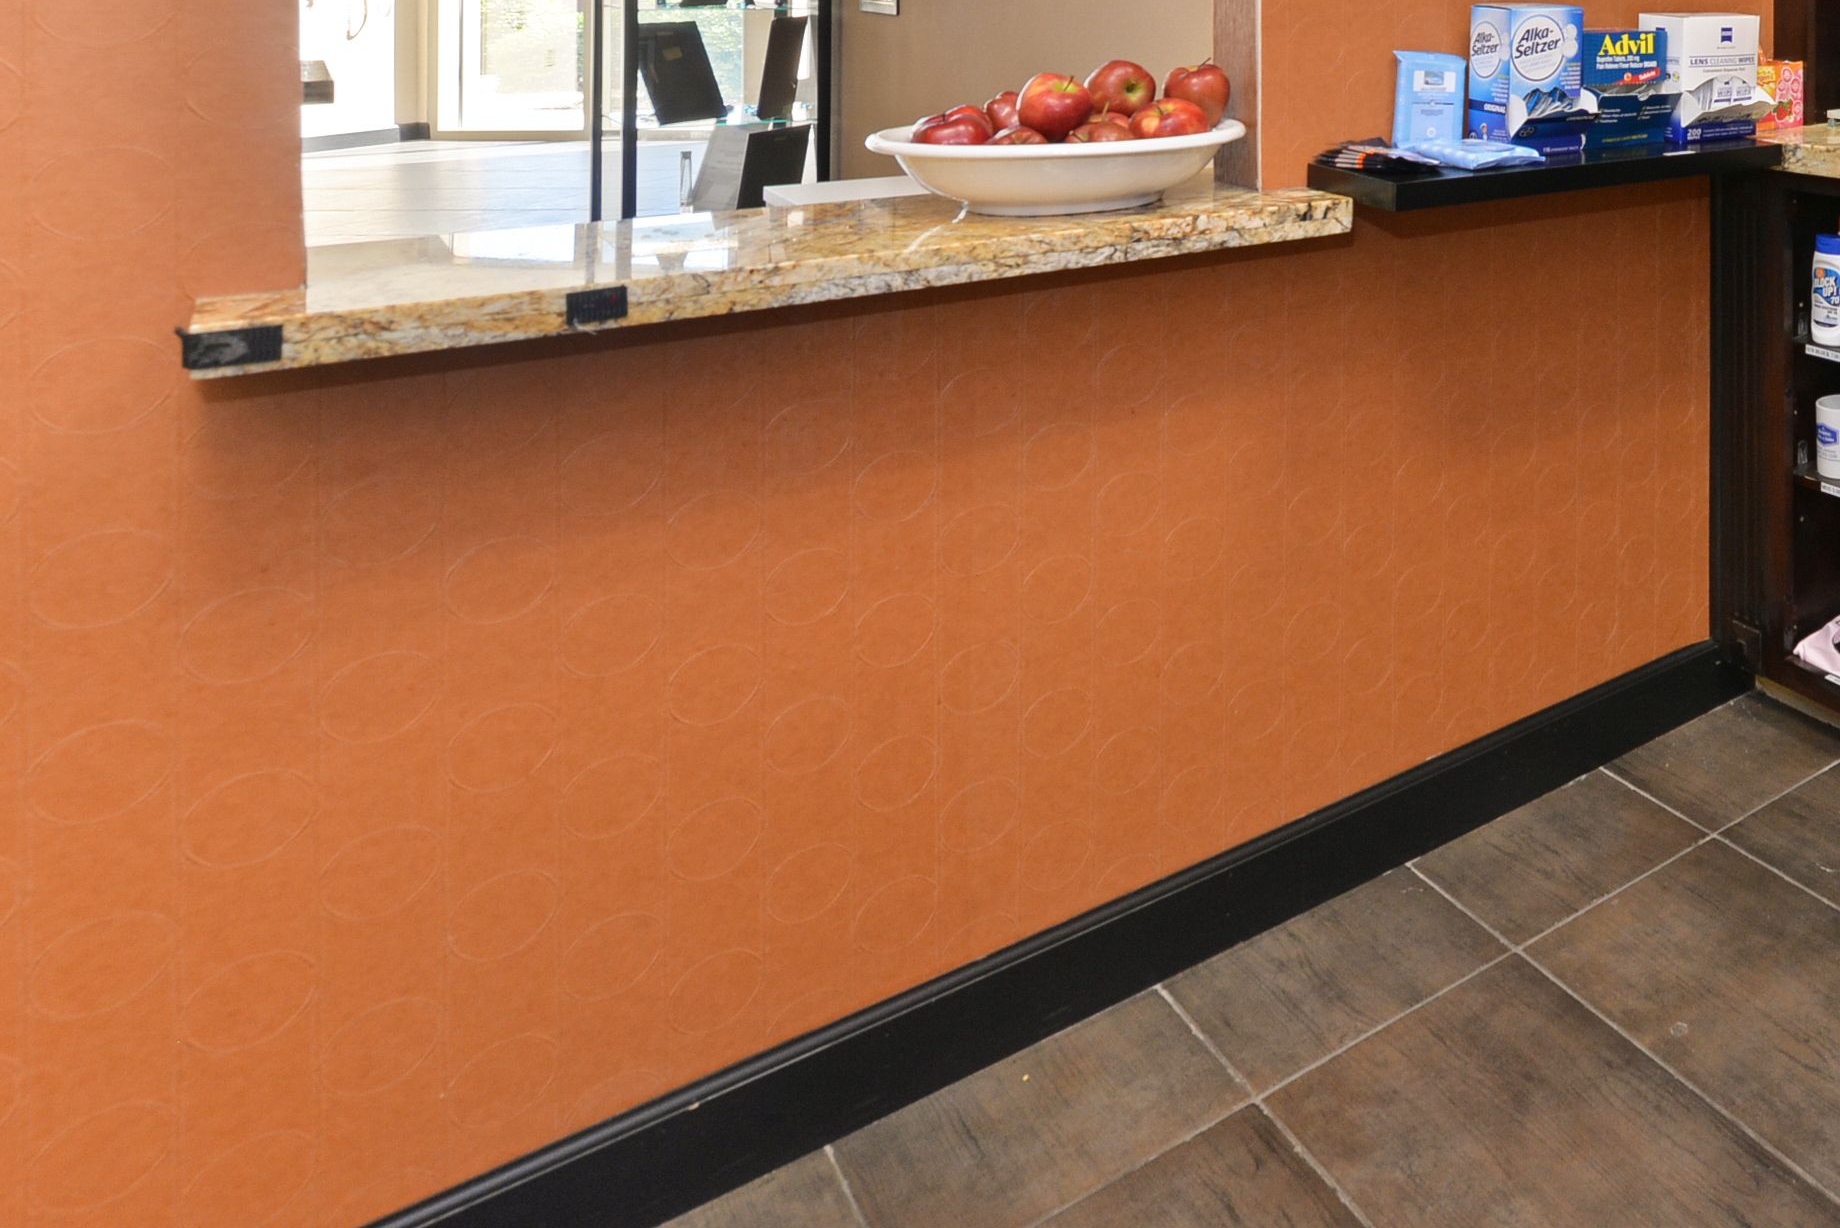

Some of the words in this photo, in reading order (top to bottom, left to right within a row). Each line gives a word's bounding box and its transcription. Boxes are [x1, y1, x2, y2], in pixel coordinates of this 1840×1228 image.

[1474, 32, 1495, 44] Alka-
[1519, 28, 1554, 44] Alka-
[1472, 43, 1500, 57] Seltzer
[1515, 38, 1561, 59] Seltzer
[1599, 33, 1655, 56] Advil
[1823, 284, 1837, 297] UP!
[1830, 296, 1839, 305] 70
